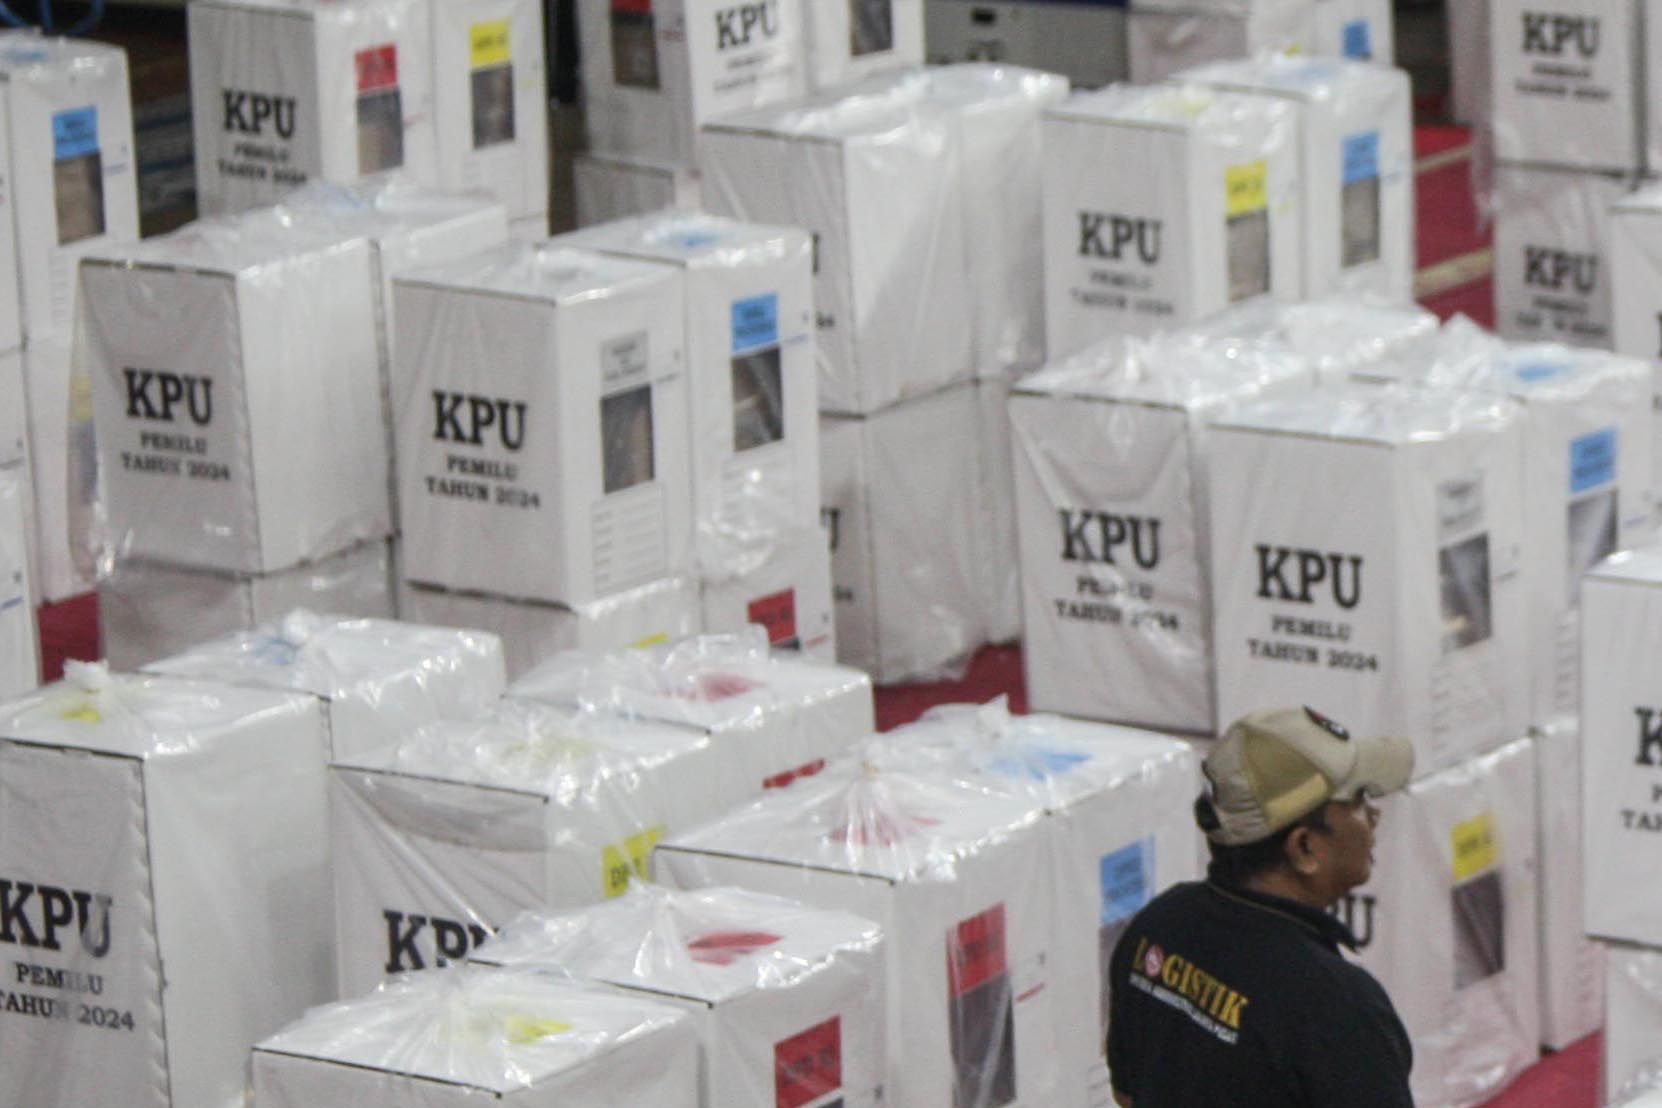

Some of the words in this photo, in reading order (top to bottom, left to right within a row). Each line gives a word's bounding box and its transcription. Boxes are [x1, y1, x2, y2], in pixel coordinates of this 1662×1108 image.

[1521, 13, 1600, 59] KPU
[222, 89, 297, 140] KPU
[1078, 211, 1162, 265] KPU
[1523, 246, 1600, 294] KPU
[123, 368, 213, 425] KPU
[432, 392, 528, 451] KPU
[1058, 509, 1162, 570] KPU
[1255, 544, 1363, 609] KPU
[0, 879, 113, 959] KPU
[79, 1004, 135, 1031] 2024
